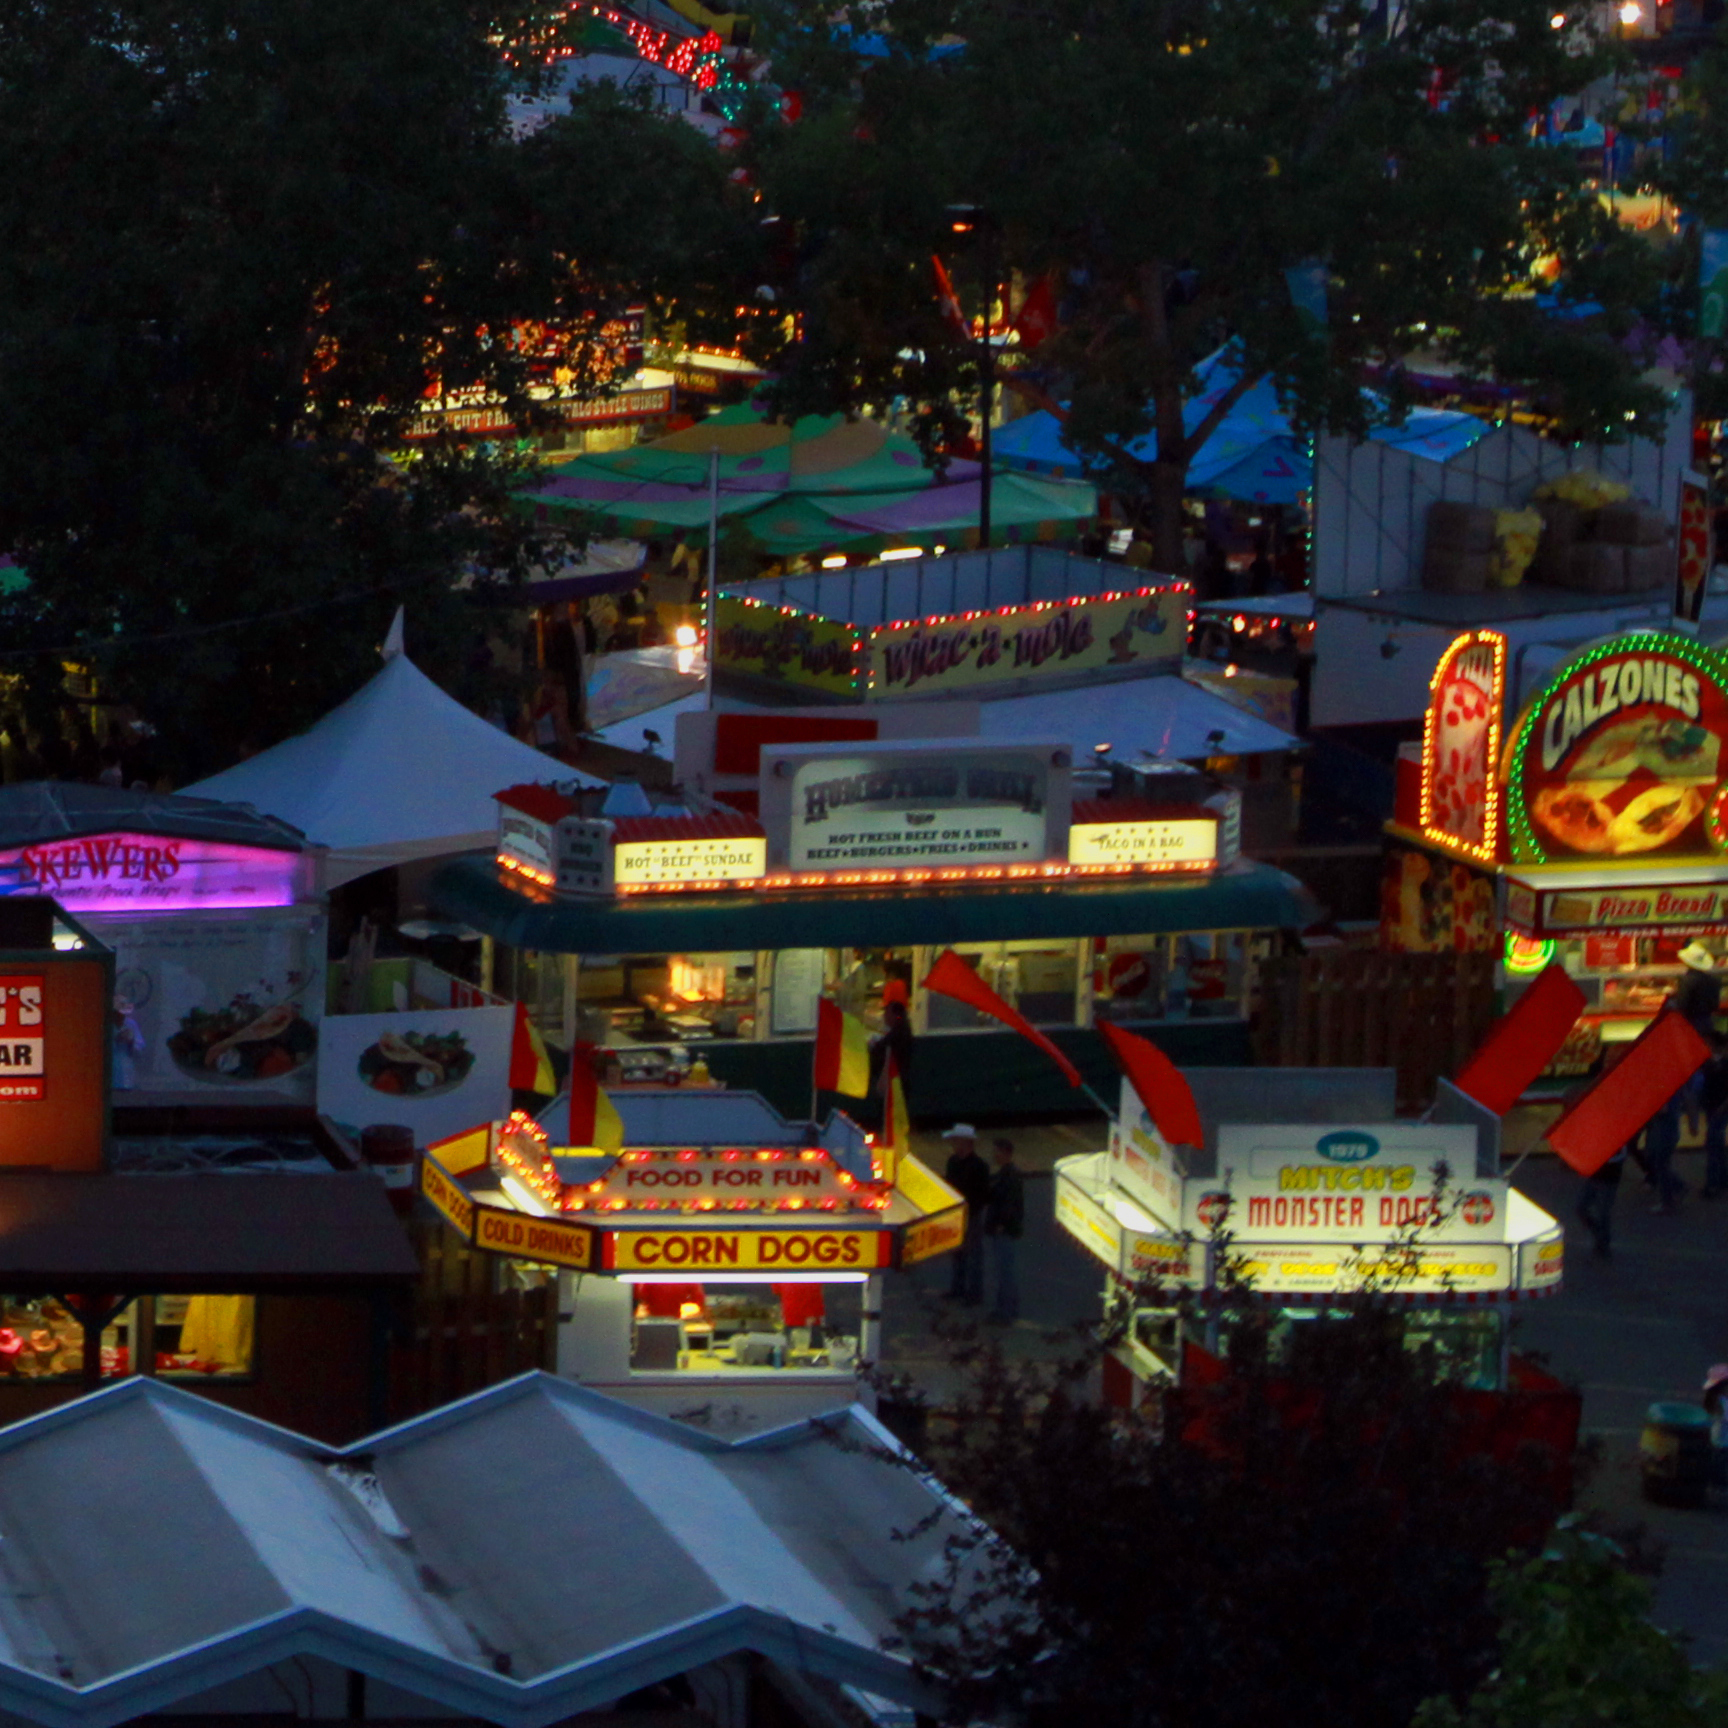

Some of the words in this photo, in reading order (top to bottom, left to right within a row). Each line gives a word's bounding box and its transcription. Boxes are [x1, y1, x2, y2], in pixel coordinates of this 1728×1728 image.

[1542, 658, 1701, 772] CALZONES
[859, 831, 902, 844] FRESH
[905, 829, 939, 842] BEEF
[941, 829, 961, 840] ON
[963, 829, 972, 839] A
[975, 828, 1002, 839] BUN
[1096, 836, 1130, 850] TACO
[1132, 838, 1146, 849] IN
[1148, 837, 1157, 848] A
[1159, 836, 1184, 848] BAG
[20, 838, 182, 887] SKEWERS
[624, 857, 652, 870] HOT
[704, 852, 754, 866] SUNDAE
[1597, 896, 1649, 920] Pizza
[1655, 891, 1717, 915] Bread
[627, 1169, 703, 1188] FOOD
[712, 1169, 763, 1186] FOR
[773, 1169, 821, 1186] FUN
[1278, 1164, 1417, 1192] MITCH'S
[1248, 1196, 1365, 1227] MONSTER
[483, 1217, 523, 1246] COLD
[528, 1226, 585, 1259] DRINKS
[633, 1235, 739, 1264] CORN
[757, 1235, 862, 1264] DOGS
